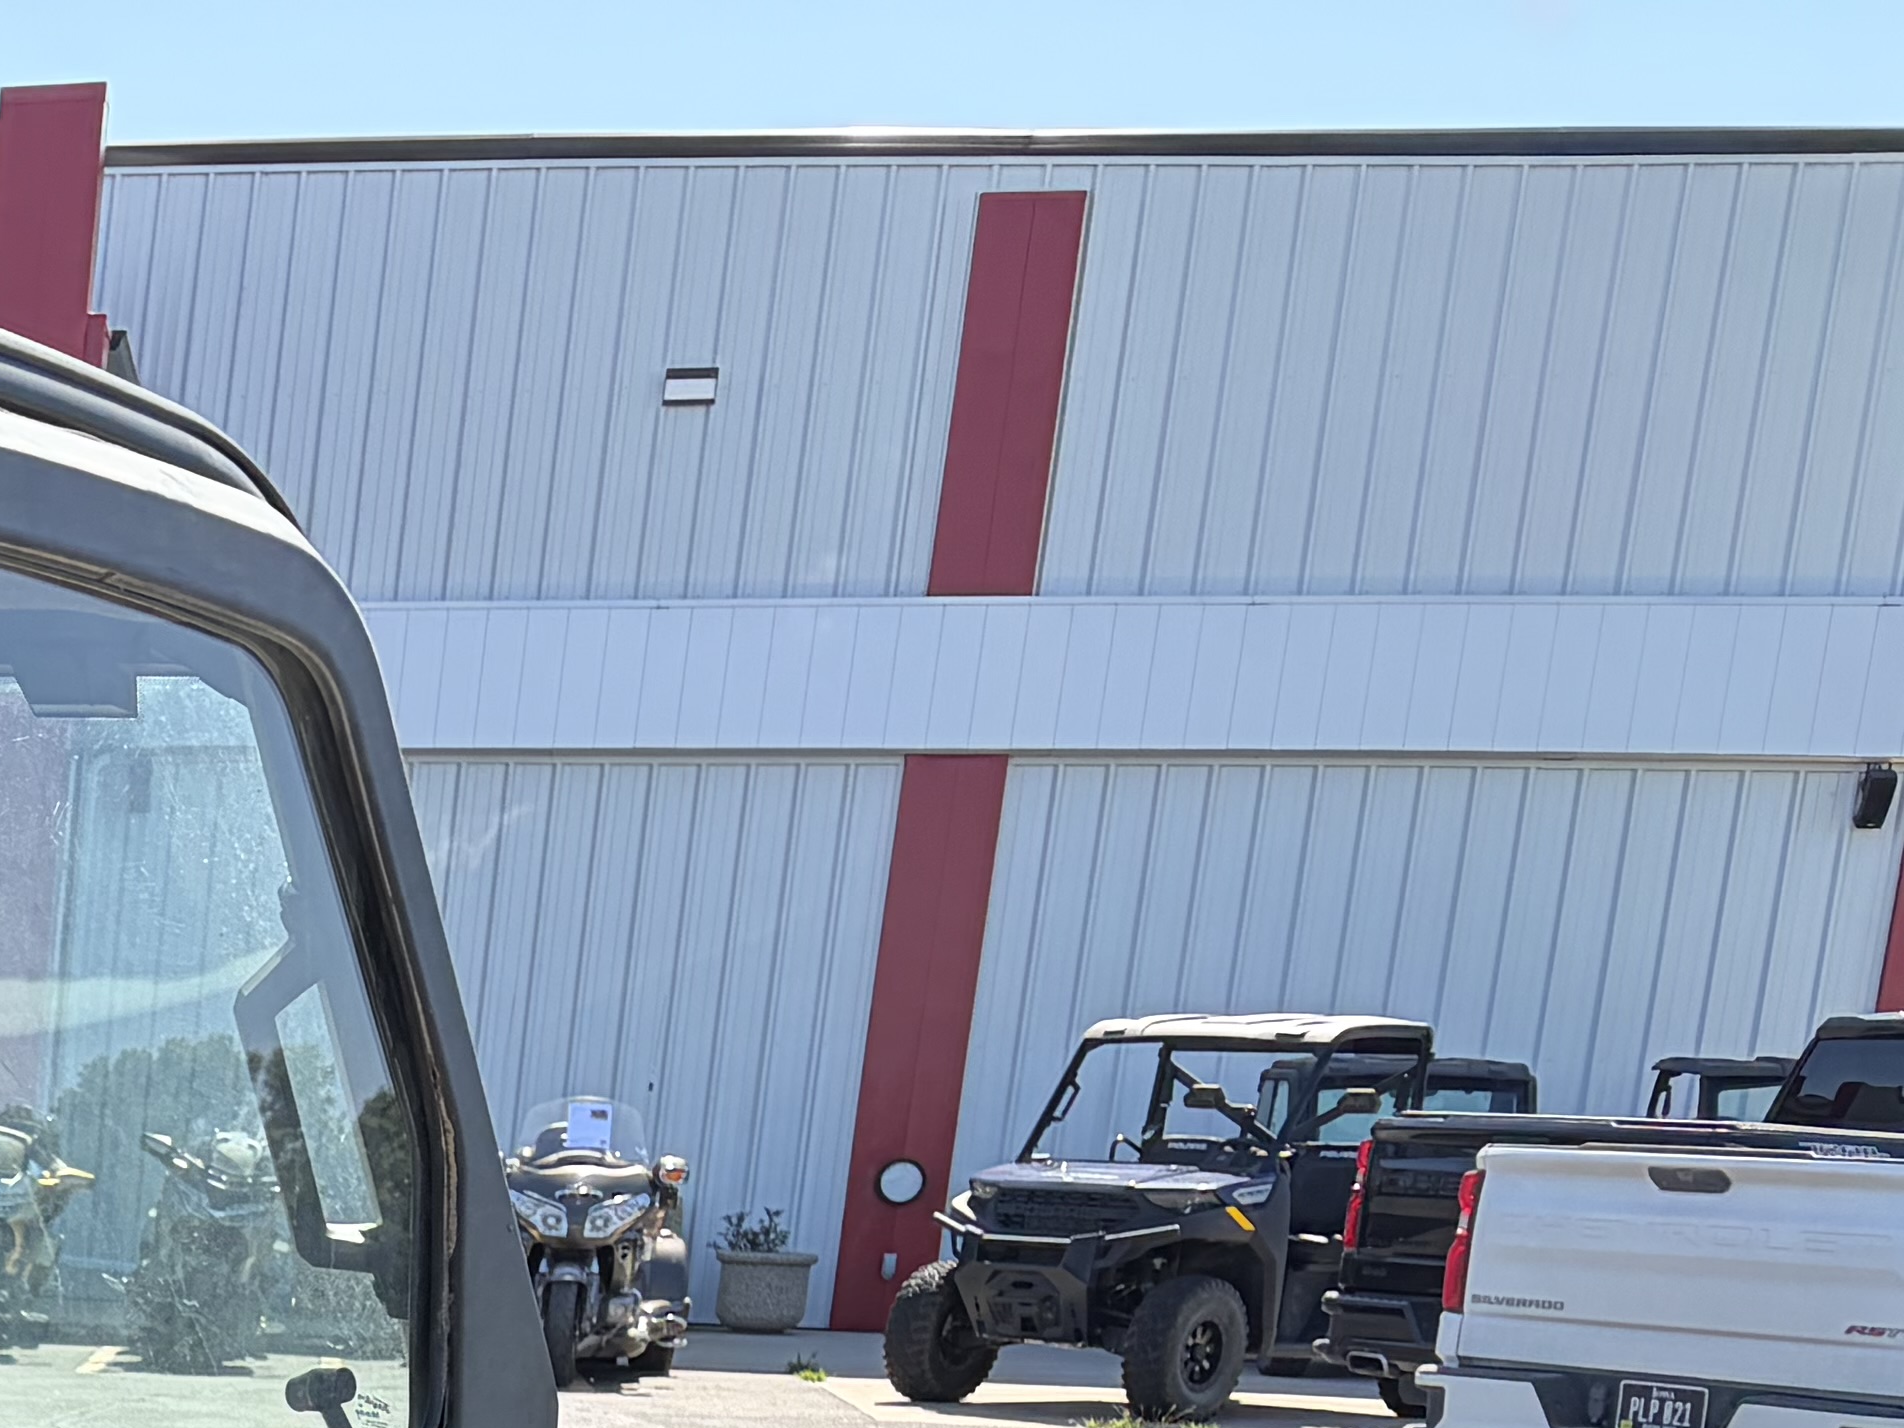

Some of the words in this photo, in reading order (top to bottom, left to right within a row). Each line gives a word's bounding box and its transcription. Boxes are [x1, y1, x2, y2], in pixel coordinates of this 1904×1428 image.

[1471, 1293, 1565, 1311] SILVERADO
[1844, 1324, 1904, 1340] RST
[1629, 1396, 1660, 1424] PLP
[1662, 1400, 1692, 1428] 021
